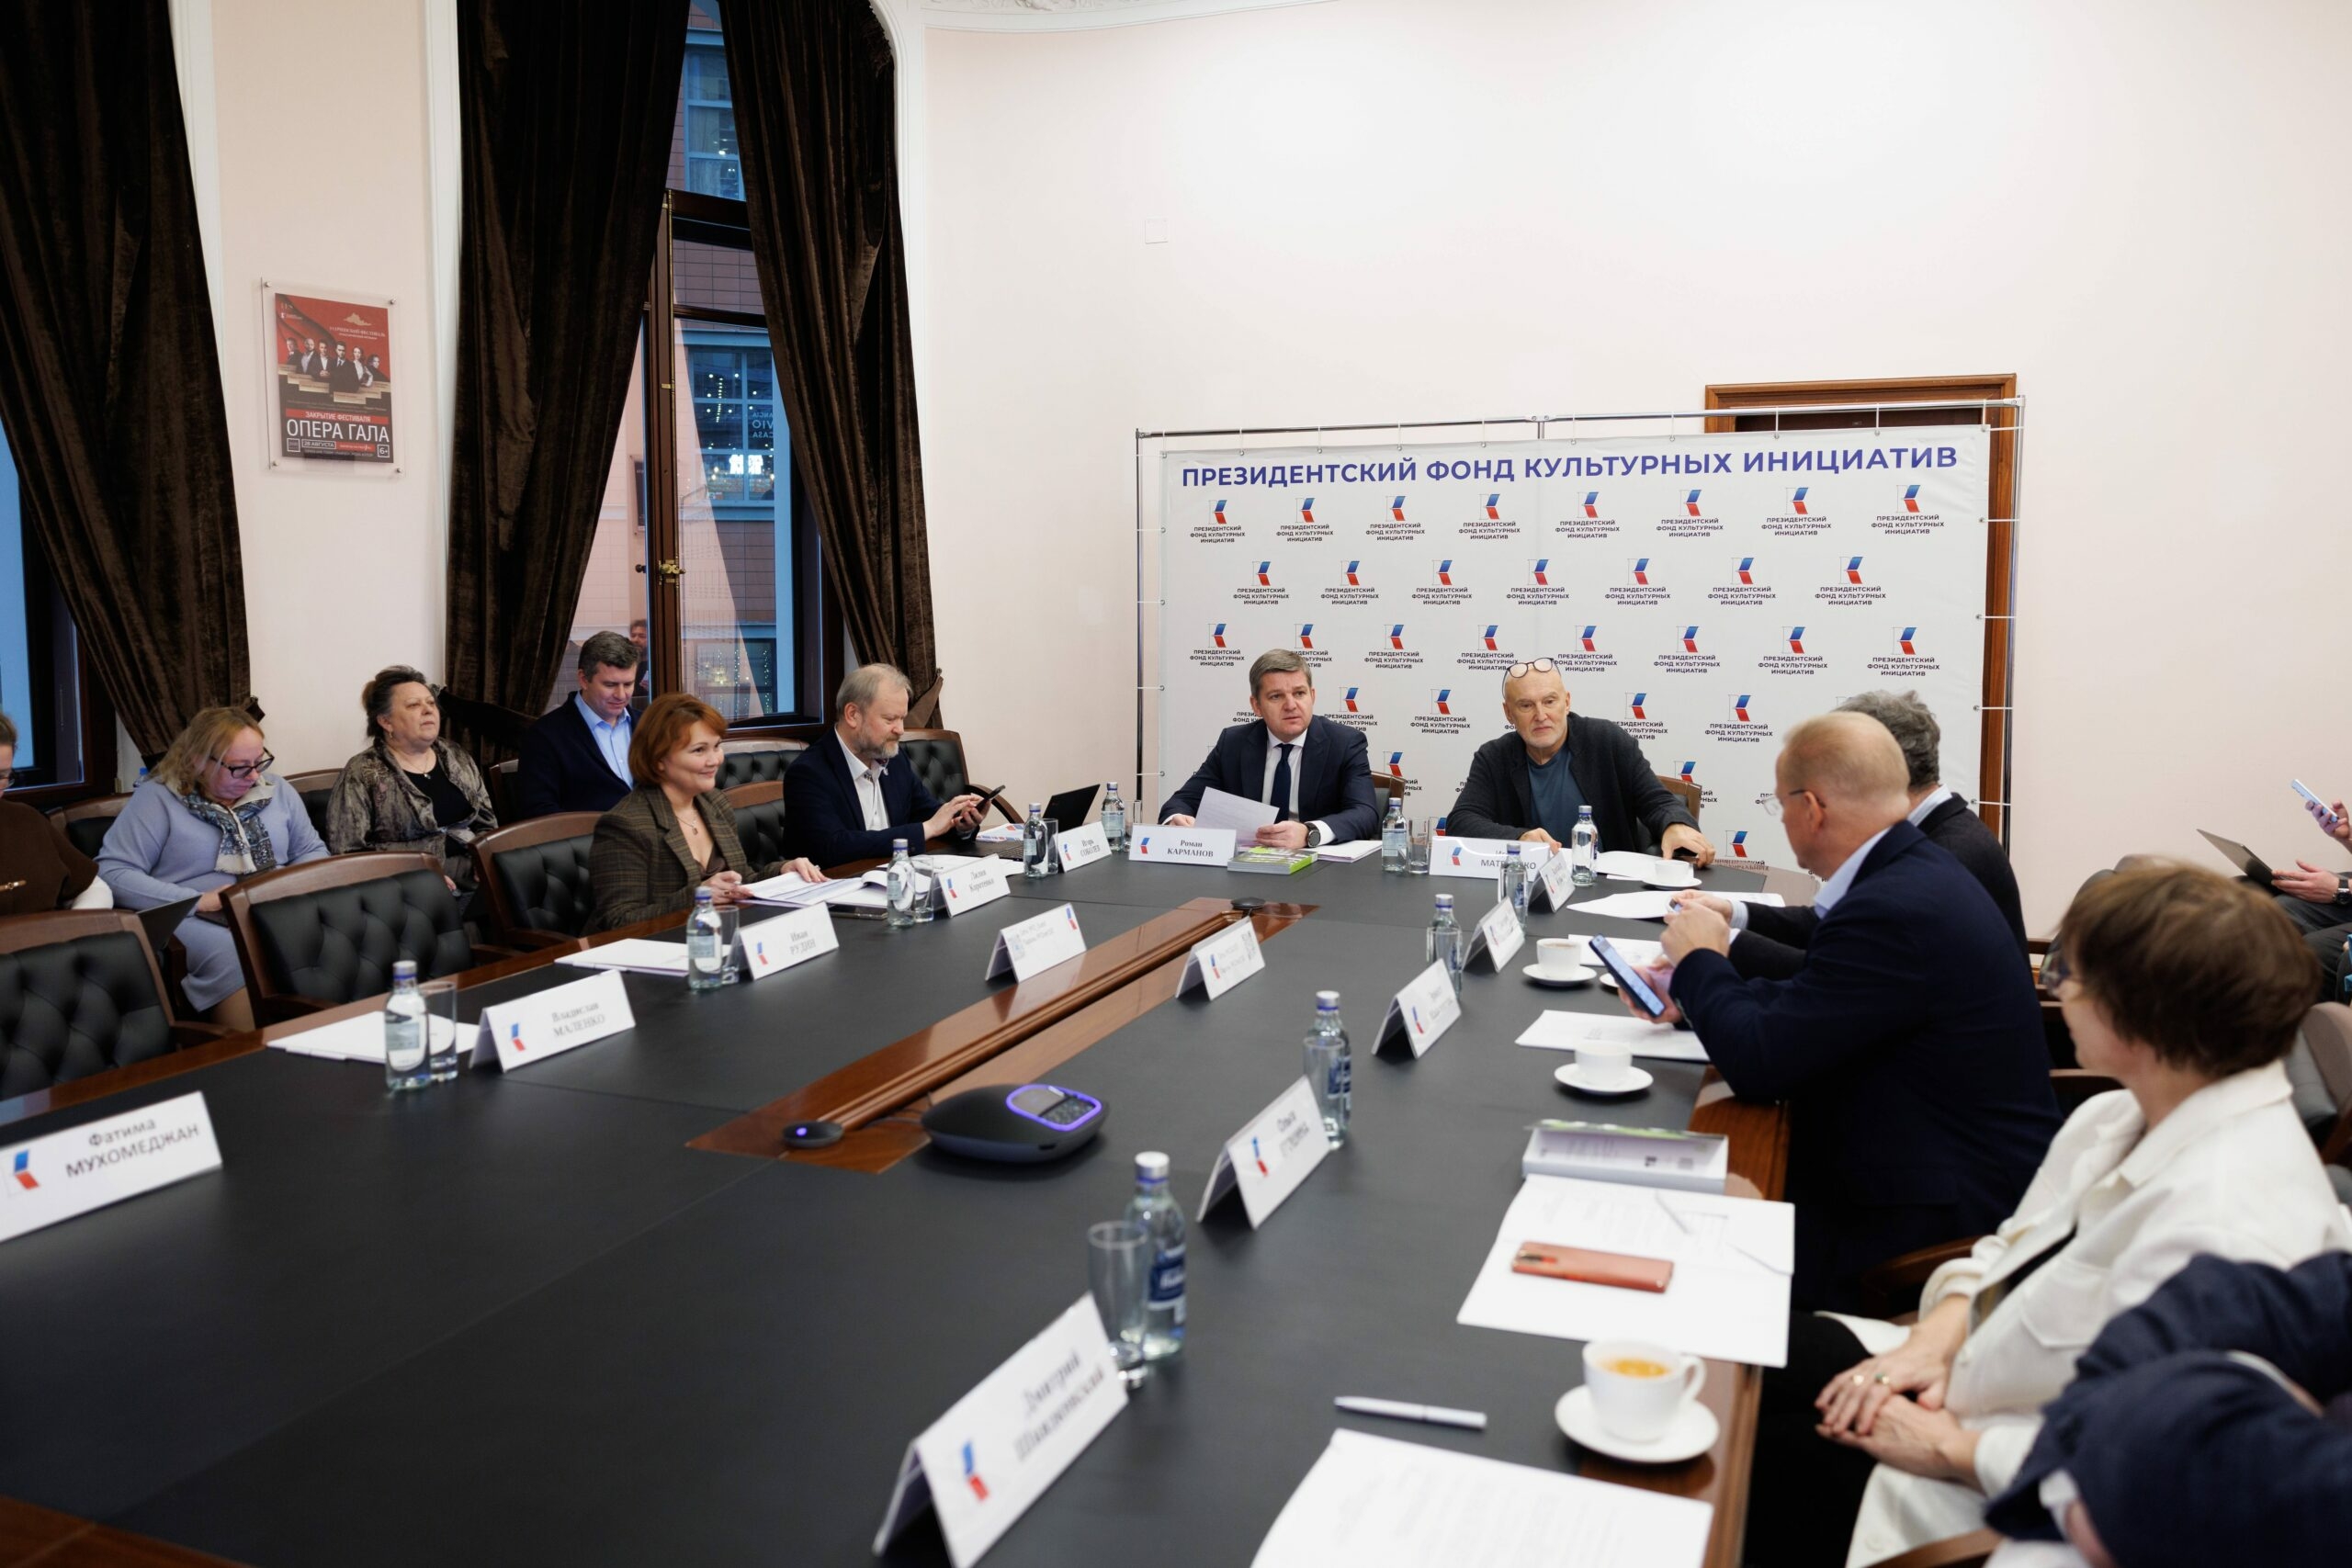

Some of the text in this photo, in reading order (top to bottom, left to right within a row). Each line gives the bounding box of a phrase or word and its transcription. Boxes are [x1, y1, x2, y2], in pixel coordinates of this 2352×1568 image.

[305, 412, 371, 423] ЗАКРЫТИЕ ФЕСТИВАЛЯ
[287, 419, 390, 443] ОПЕРА ГАЛА
[1183, 446, 1957, 487] ПРЕЗИДЕНТСКИЙ ФОНД КУЛЬТУРНЫХ ИНИЦИАТИВ
[1167, 848, 1214, 857] КАРМАНОВ
[1180, 839, 1203, 848] Роман
[89, 1118, 156, 1146] Фатима
[65, 1123, 199, 1179] МУХОМЕДЖАН
